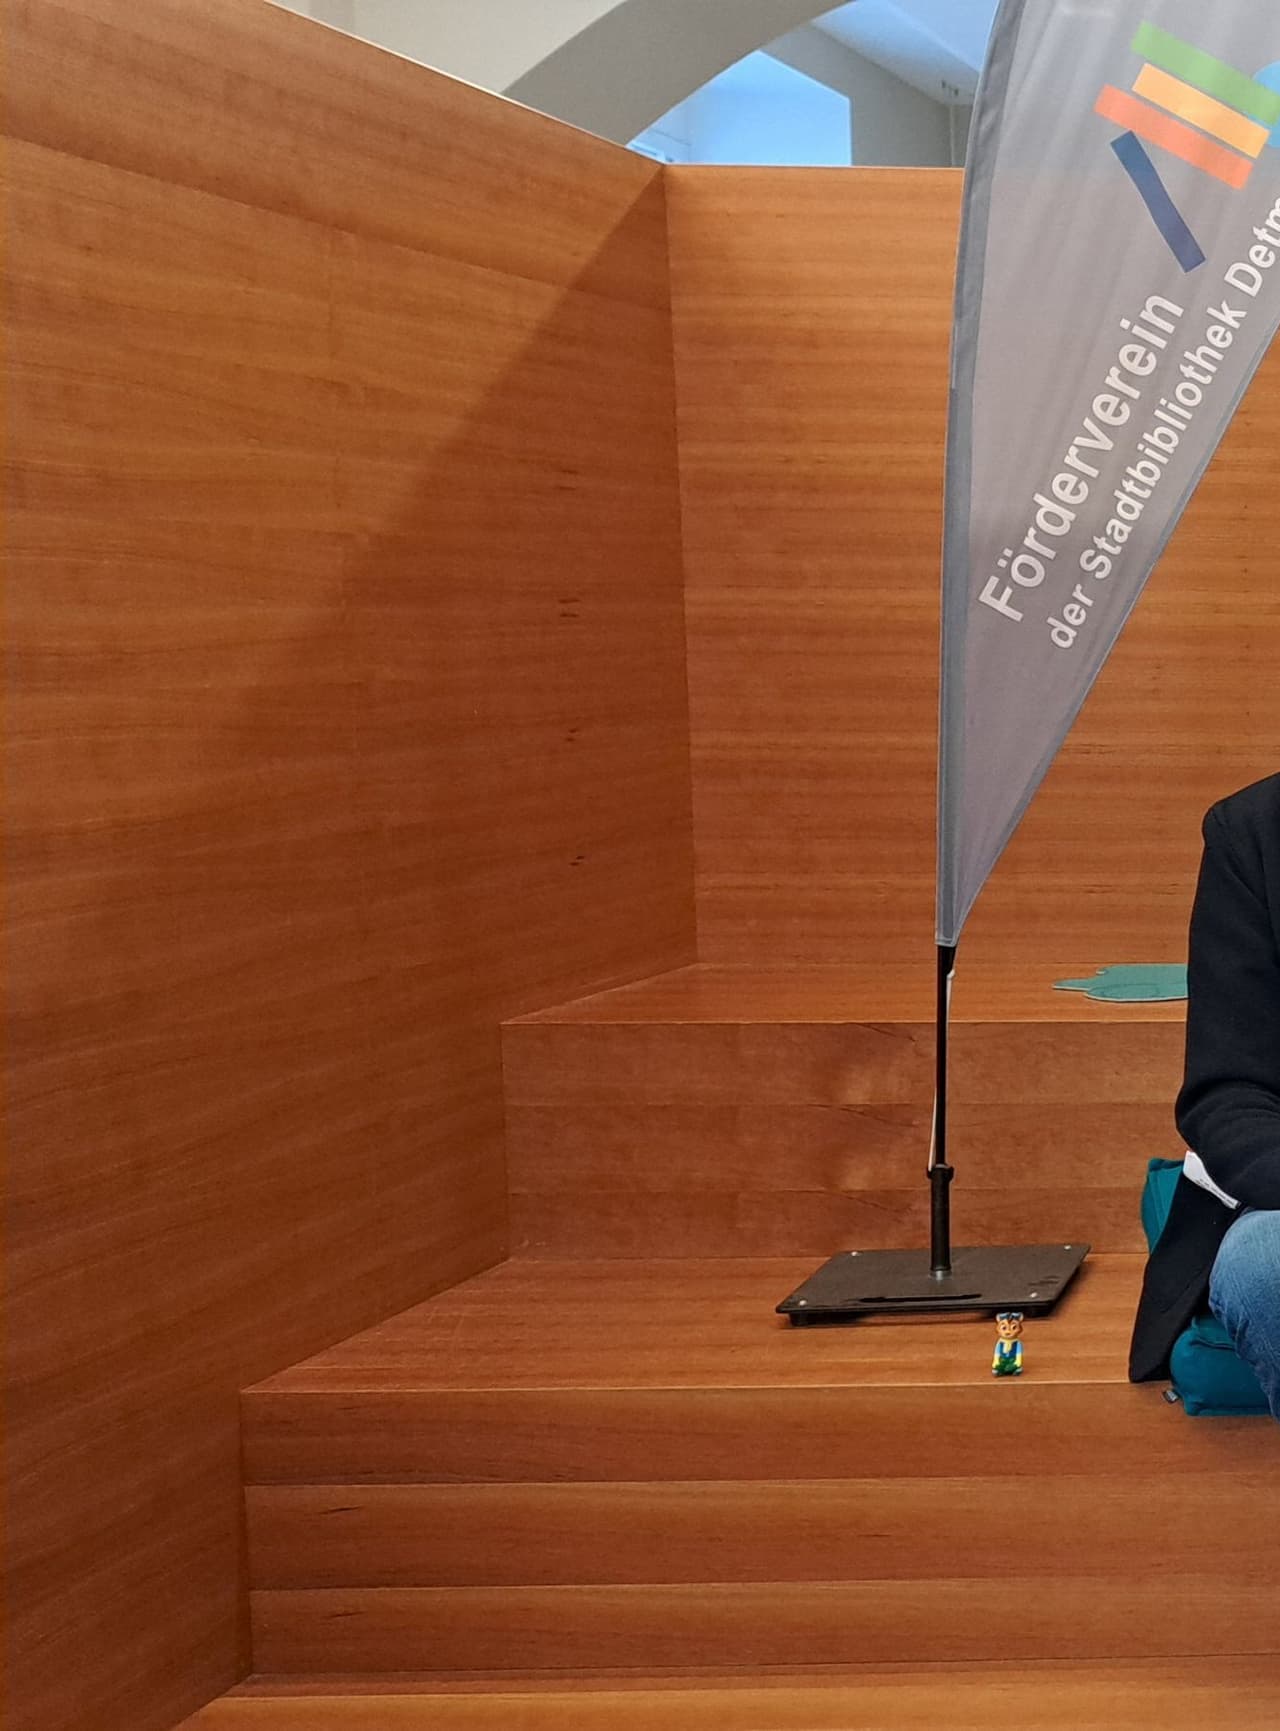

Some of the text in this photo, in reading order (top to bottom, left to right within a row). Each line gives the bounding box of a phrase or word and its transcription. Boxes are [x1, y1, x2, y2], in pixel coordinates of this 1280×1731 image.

[979, 294, 1184, 623] Förderverein
[1050, 583, 1096, 650] der
[1079, 298, 1248, 580] Stadtbibliothek
